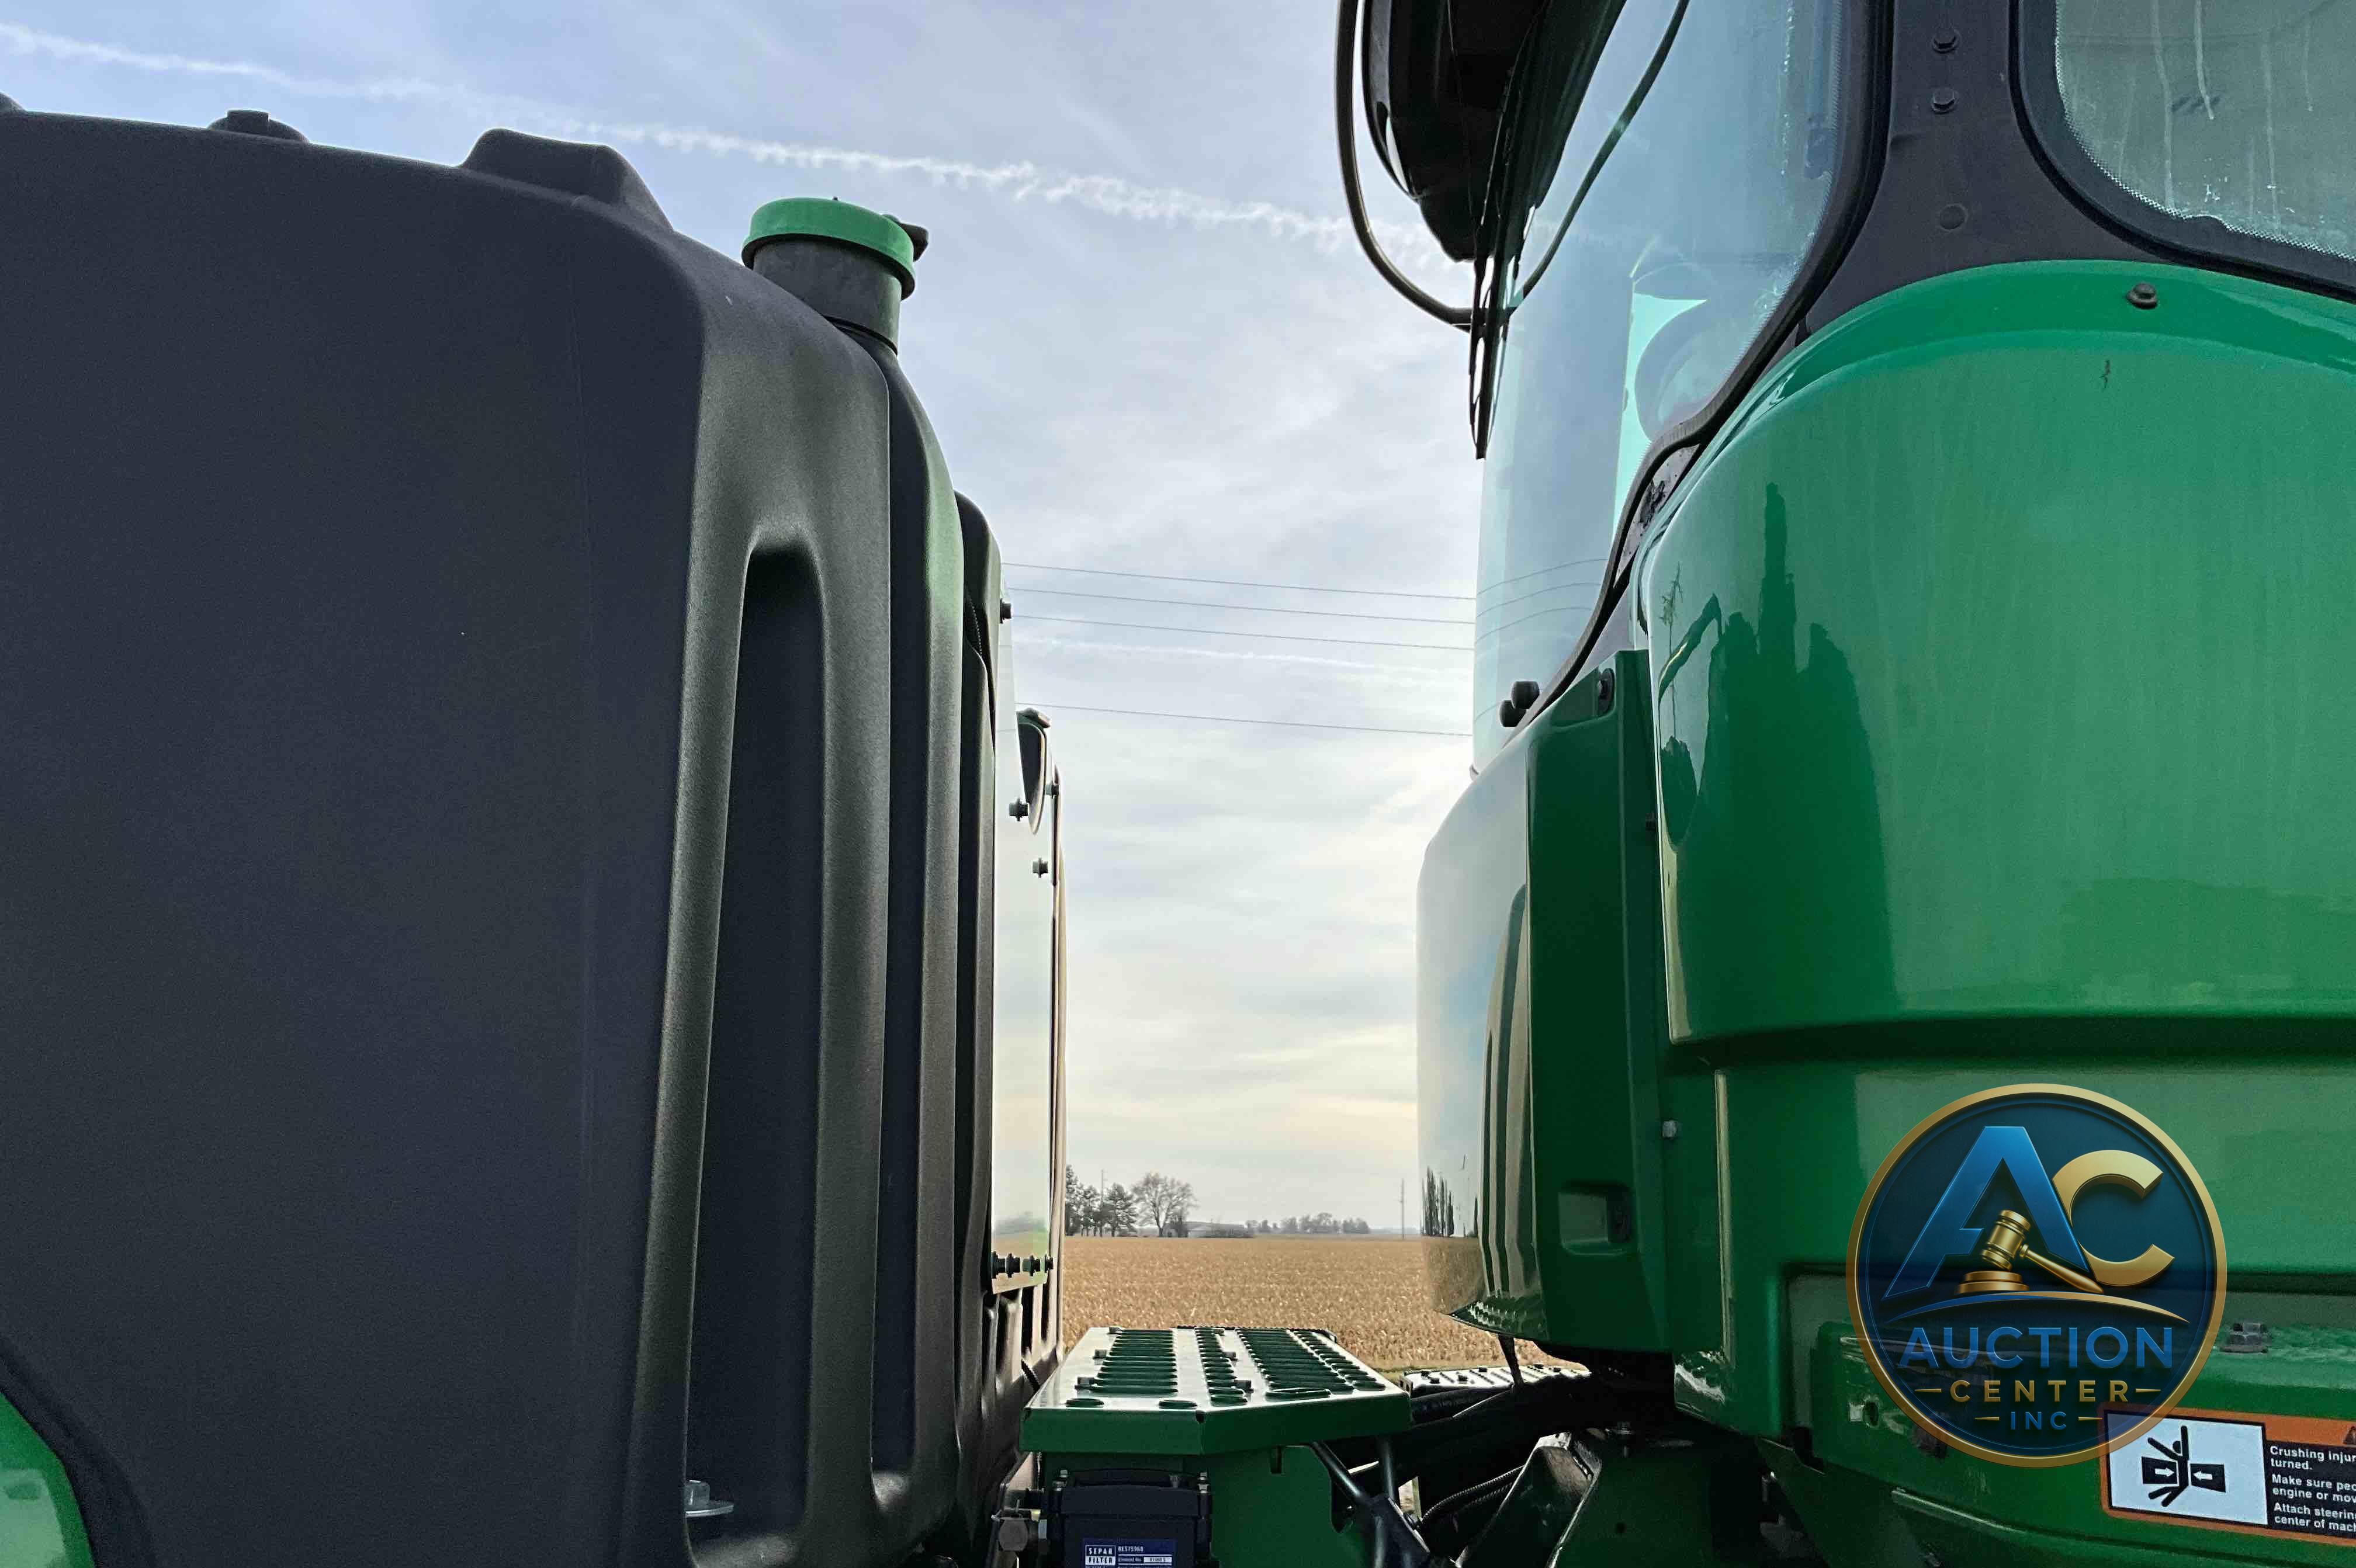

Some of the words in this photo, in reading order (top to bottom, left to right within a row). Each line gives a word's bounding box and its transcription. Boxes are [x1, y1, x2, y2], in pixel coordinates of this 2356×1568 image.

[2270, 1446, 2324, 1461] Crushing
[2271, 1458, 2313, 1470] turned.
[2272, 1473, 2302, 1486] Make
[2306, 1479, 2333, 1489] sure
[2272, 1487, 2312, 1498] engine
[2274, 1502, 2311, 1515] Attach
[2314, 1508, 2356, 1520] steerin
[2275, 1516, 2311, 1527] center
[2314, 1519, 2325, 1528] of
[1089, 1556, 1113, 1564] FILTER
